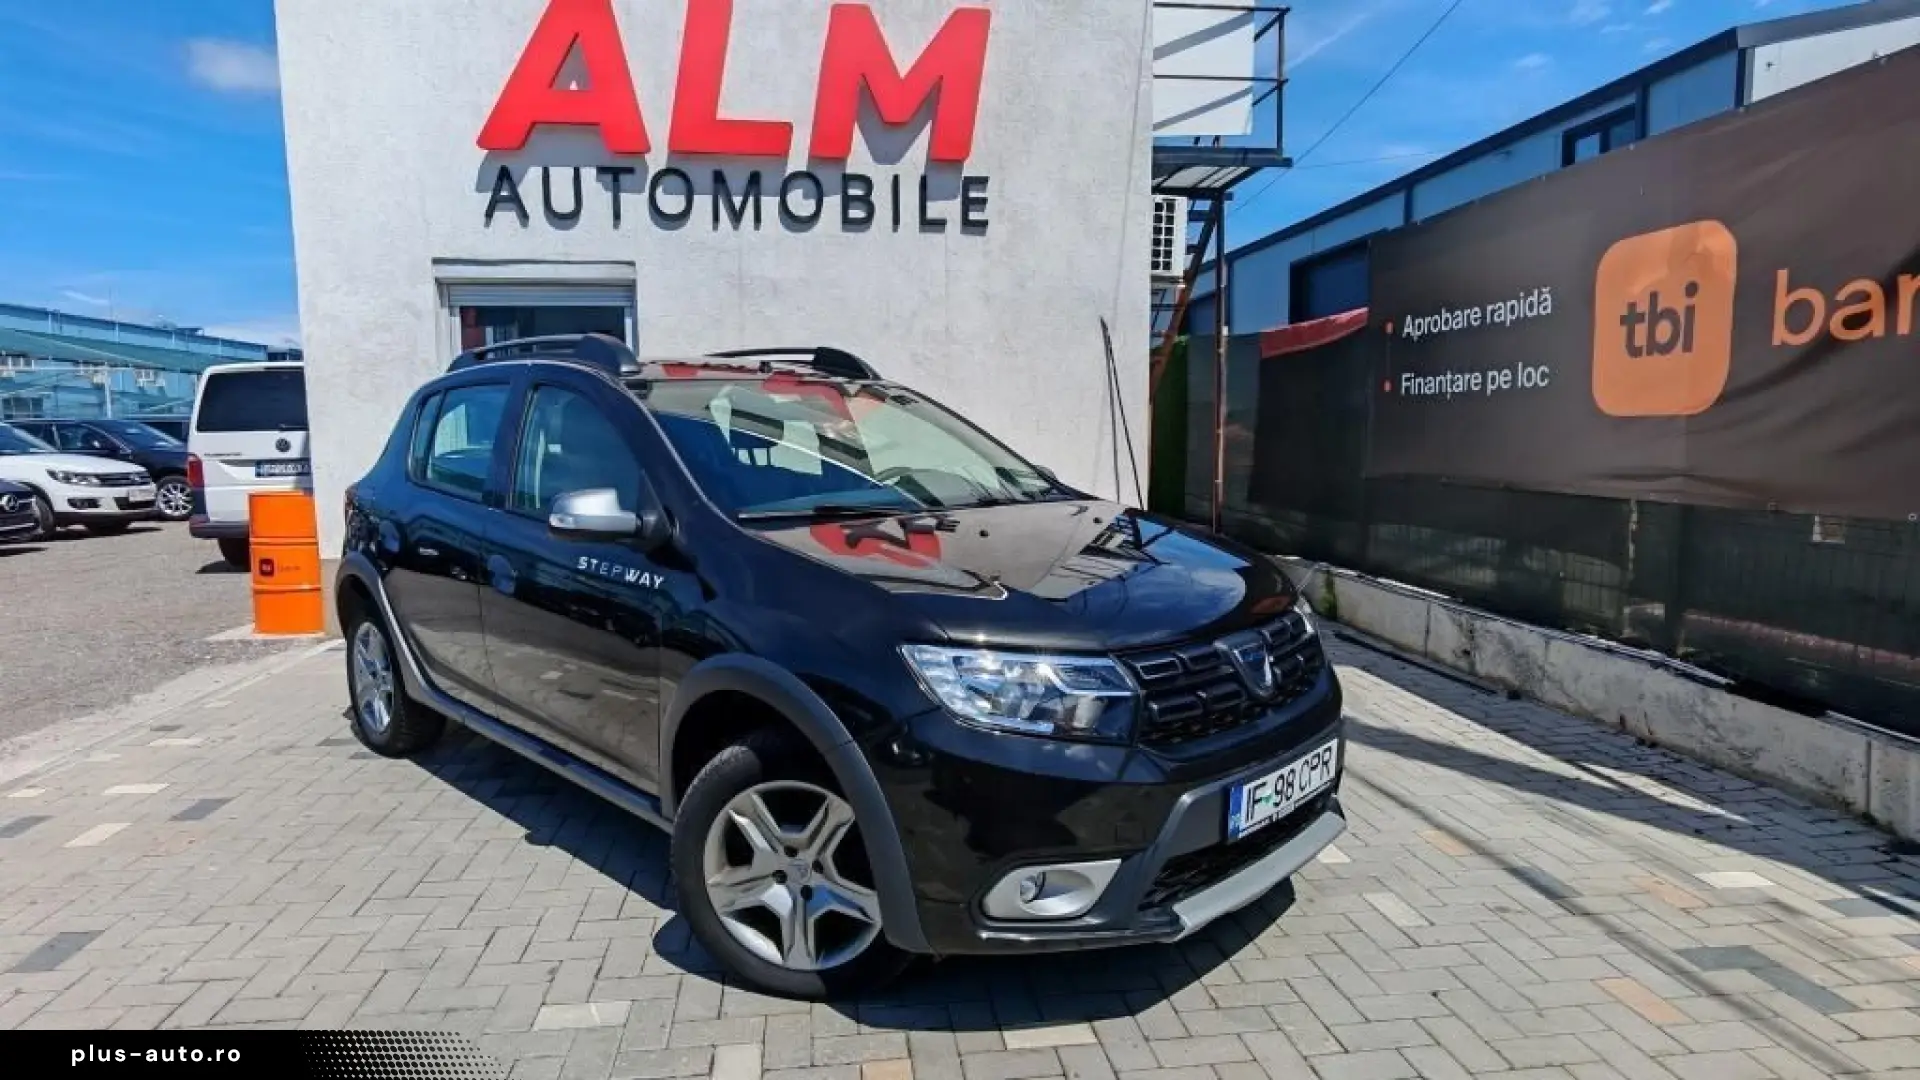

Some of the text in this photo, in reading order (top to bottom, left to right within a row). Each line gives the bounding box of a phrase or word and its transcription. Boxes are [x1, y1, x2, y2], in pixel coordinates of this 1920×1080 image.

[476, 0, 990, 161] ALM
[484, 165, 989, 231] AUTOMOBILE
[1402, 286, 1552, 342] Aprobare rapidă
[1619, 281, 1701, 359] tbi
[1401, 361, 1550, 400] Finanțare pe loc
[577, 556, 664, 589] STEPWAY
[1273, 768, 1297, 808] 98
[1300, 745, 1332, 792] CPR
